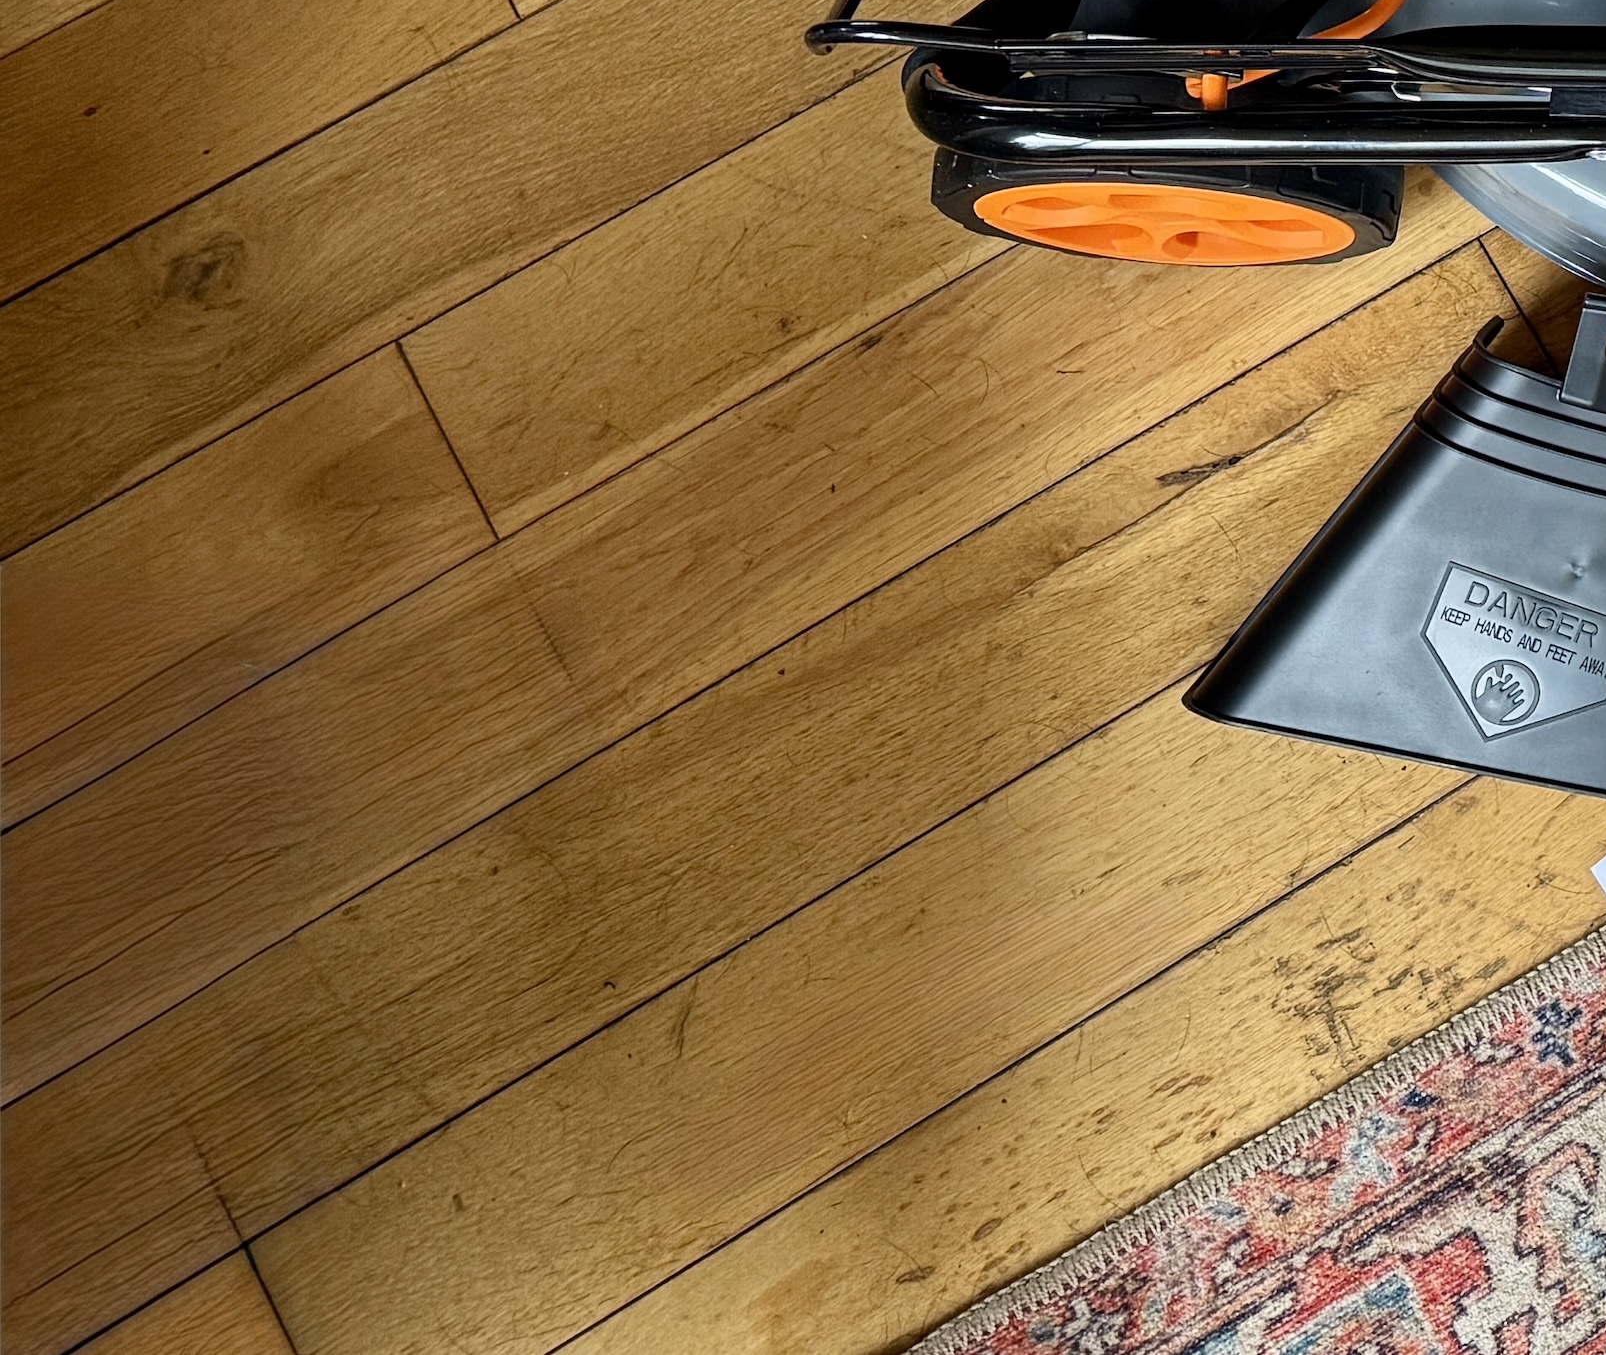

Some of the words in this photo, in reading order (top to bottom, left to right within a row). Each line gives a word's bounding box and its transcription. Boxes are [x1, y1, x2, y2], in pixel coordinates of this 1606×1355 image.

[1440, 605, 1471, 626] KEEP
[1474, 617, 1514, 643] HANDS
[1517, 634, 1542, 653] AND
[1545, 644, 1578, 665] FEET
[1464, 581, 1599, 649] DANGER
